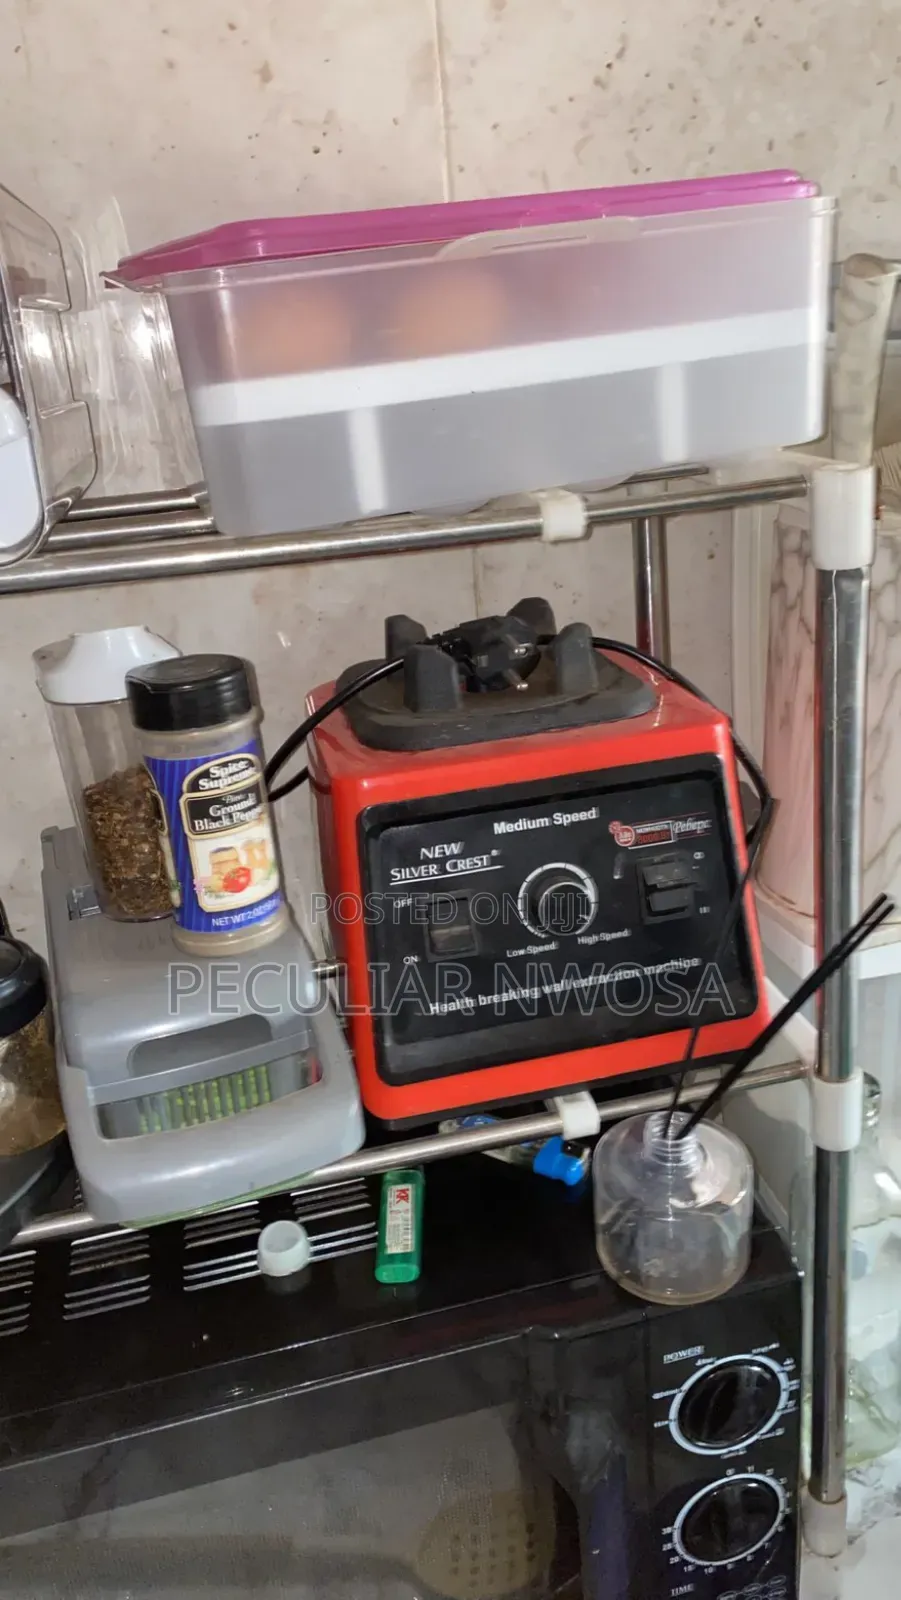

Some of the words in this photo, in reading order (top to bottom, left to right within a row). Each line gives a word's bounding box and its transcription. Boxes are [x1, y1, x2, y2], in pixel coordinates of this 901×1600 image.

[209, 760, 250, 778] Spice
[209, 792, 256, 817] Ground
[194, 812, 231, 832] Black
[493, 815, 550, 835] Medium
[552, 807, 599, 828] Speed
[420, 841, 464, 860] NEW
[390, 863, 439, 881] SILVER
[445, 854, 490, 873] CREST
[393, 898, 413, 908] OFF
[211, 914, 230, 927] NET
[577, 933, 599, 945] High
[599, 928, 632, 943] Speed
[506, 946, 526, 958] Low
[526, 941, 559, 955] Speed
[403, 955, 419, 965] ON
[429, 996, 477, 1015] Health
[478, 986, 541, 1007] breaking
[643, 956, 702, 976] machine
[663, 1345, 705, 1364] POWER
